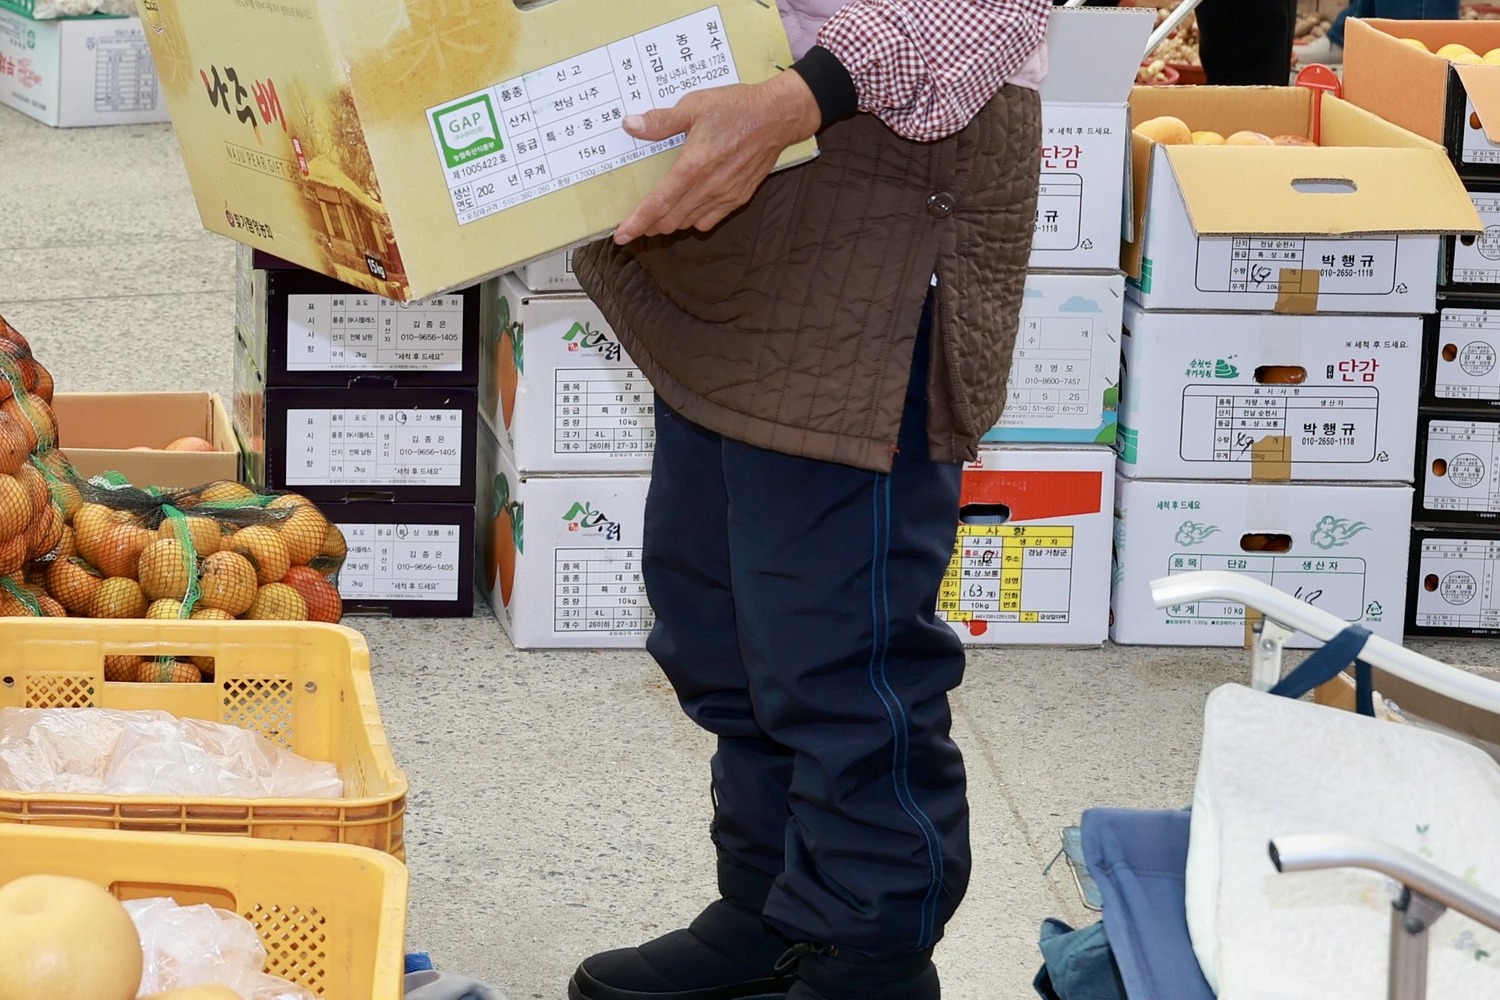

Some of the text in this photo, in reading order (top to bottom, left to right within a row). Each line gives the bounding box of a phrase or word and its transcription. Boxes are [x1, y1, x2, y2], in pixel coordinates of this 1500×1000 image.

[669, 63, 688, 80] 나주시
[708, 52, 726, 67] 1728
[658, 65, 730, 98] 010-3621-0226
[501, 85, 524, 102] 품종
[200, 63, 288, 146] 나주배
[508, 86, 600, 128] 산지 전남 나주
[449, 112, 481, 133] GAP
[1057, 127, 1073, 135] 세척
[1076, 127, 1083, 135] 후
[516, 138, 539, 154] 등급
[226, 144, 246, 163] NAJU
[247, 151, 267, 170] PEAR
[268, 157, 286, 177] GIFT
[524, 144, 606, 180] 무게 15kg
[1041, 145, 1083, 169] 단감
[453, 186, 471, 200] 생산
[456, 175, 519, 213] 연도 202 년
[1320, 268, 1374, 277] 010-2650-1118
[401, 333, 458, 341] 010-9656-1405
[1354, 340, 1370, 349] 세척
[1373, 341, 1380, 349] 후
[1338, 359, 1380, 382] 단감
[1025, 377, 1081, 385] 010-8600-7457
[1013, 392, 1020, 400] M
[618, 418, 638, 426] 10kg
[594, 430, 605, 438] 4L
[622, 430, 633, 438] 3L
[1302, 437, 1355, 446] 010-2650-1118
[400, 448, 457, 456] 010-9656-1405
[1156, 501, 1201, 510] 세척 후 드세요
[1227, 559, 1247, 569] 단감
[618, 597, 637, 605] 10kg
[594, 609, 605, 617] 4L
[621, 609, 632, 617] 3L
